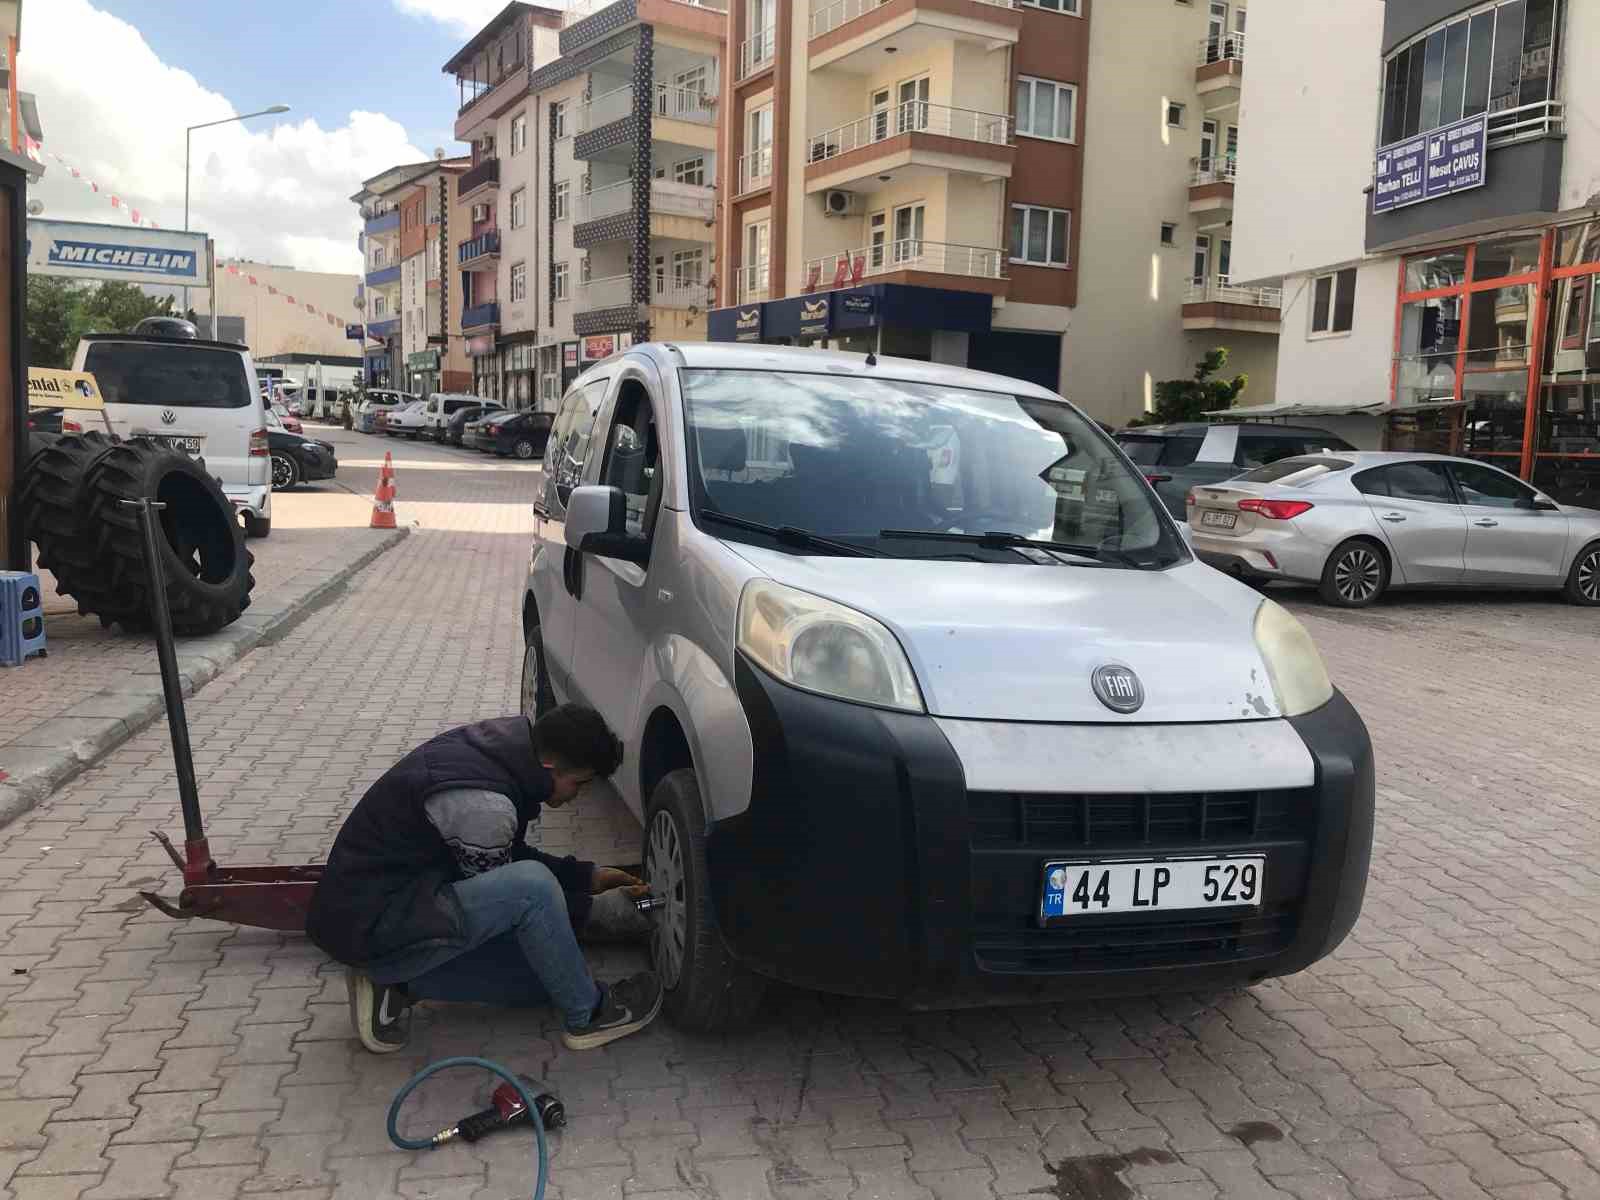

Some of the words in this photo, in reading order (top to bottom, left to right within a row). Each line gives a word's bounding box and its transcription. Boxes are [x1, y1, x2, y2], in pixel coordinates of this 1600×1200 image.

[1452, 152, 1480, 176] ÇAVUŞ
[58, 245, 191, 270] MICHELIN
[1104, 675, 1134, 697] FIAT
[1047, 893, 1063, 905] TR
[1071, 869, 1111, 910] 44
[1132, 867, 1171, 907] LP
[1203, 863, 1257, 903] 529
